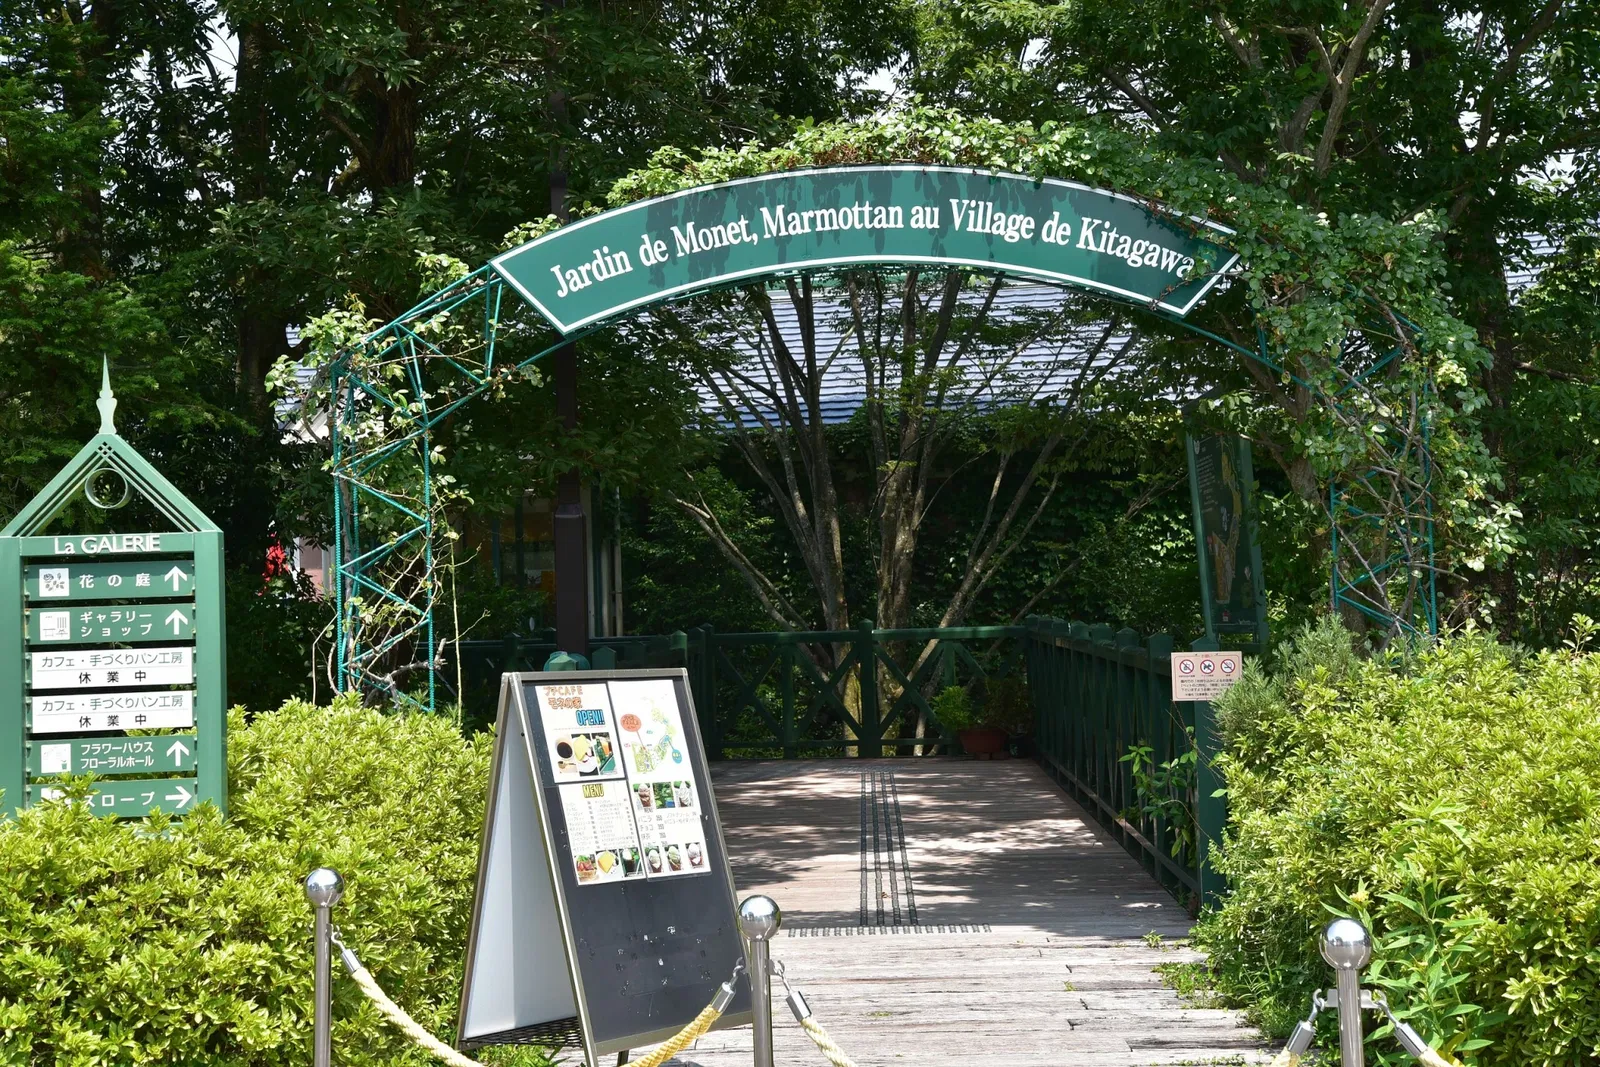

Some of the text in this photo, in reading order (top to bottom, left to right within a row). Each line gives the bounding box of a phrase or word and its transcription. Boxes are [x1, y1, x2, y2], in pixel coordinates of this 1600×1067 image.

[550, 198, 1195, 298] Jardin de Monet, Marmottan au Village de Kitagawa
[54, 535, 161, 555] La GALERIE
[79, 573, 151, 589] 花の庭
[80, 610, 152, 624] ギャラリー
[80, 623, 153, 637] ショップ
[42, 651, 183, 668] カフェ・手づくりパン工房
[79, 670, 147, 685] 休業中
[42, 694, 183, 712] カフェ・手づくりパン工房
[79, 714, 147, 728] 休業中
[80, 741, 154, 756] フラワーハウス
[80, 755, 154, 770] フローラルホール
[582, 783, 604, 798] MENU
[84, 791, 155, 807] スロープ
